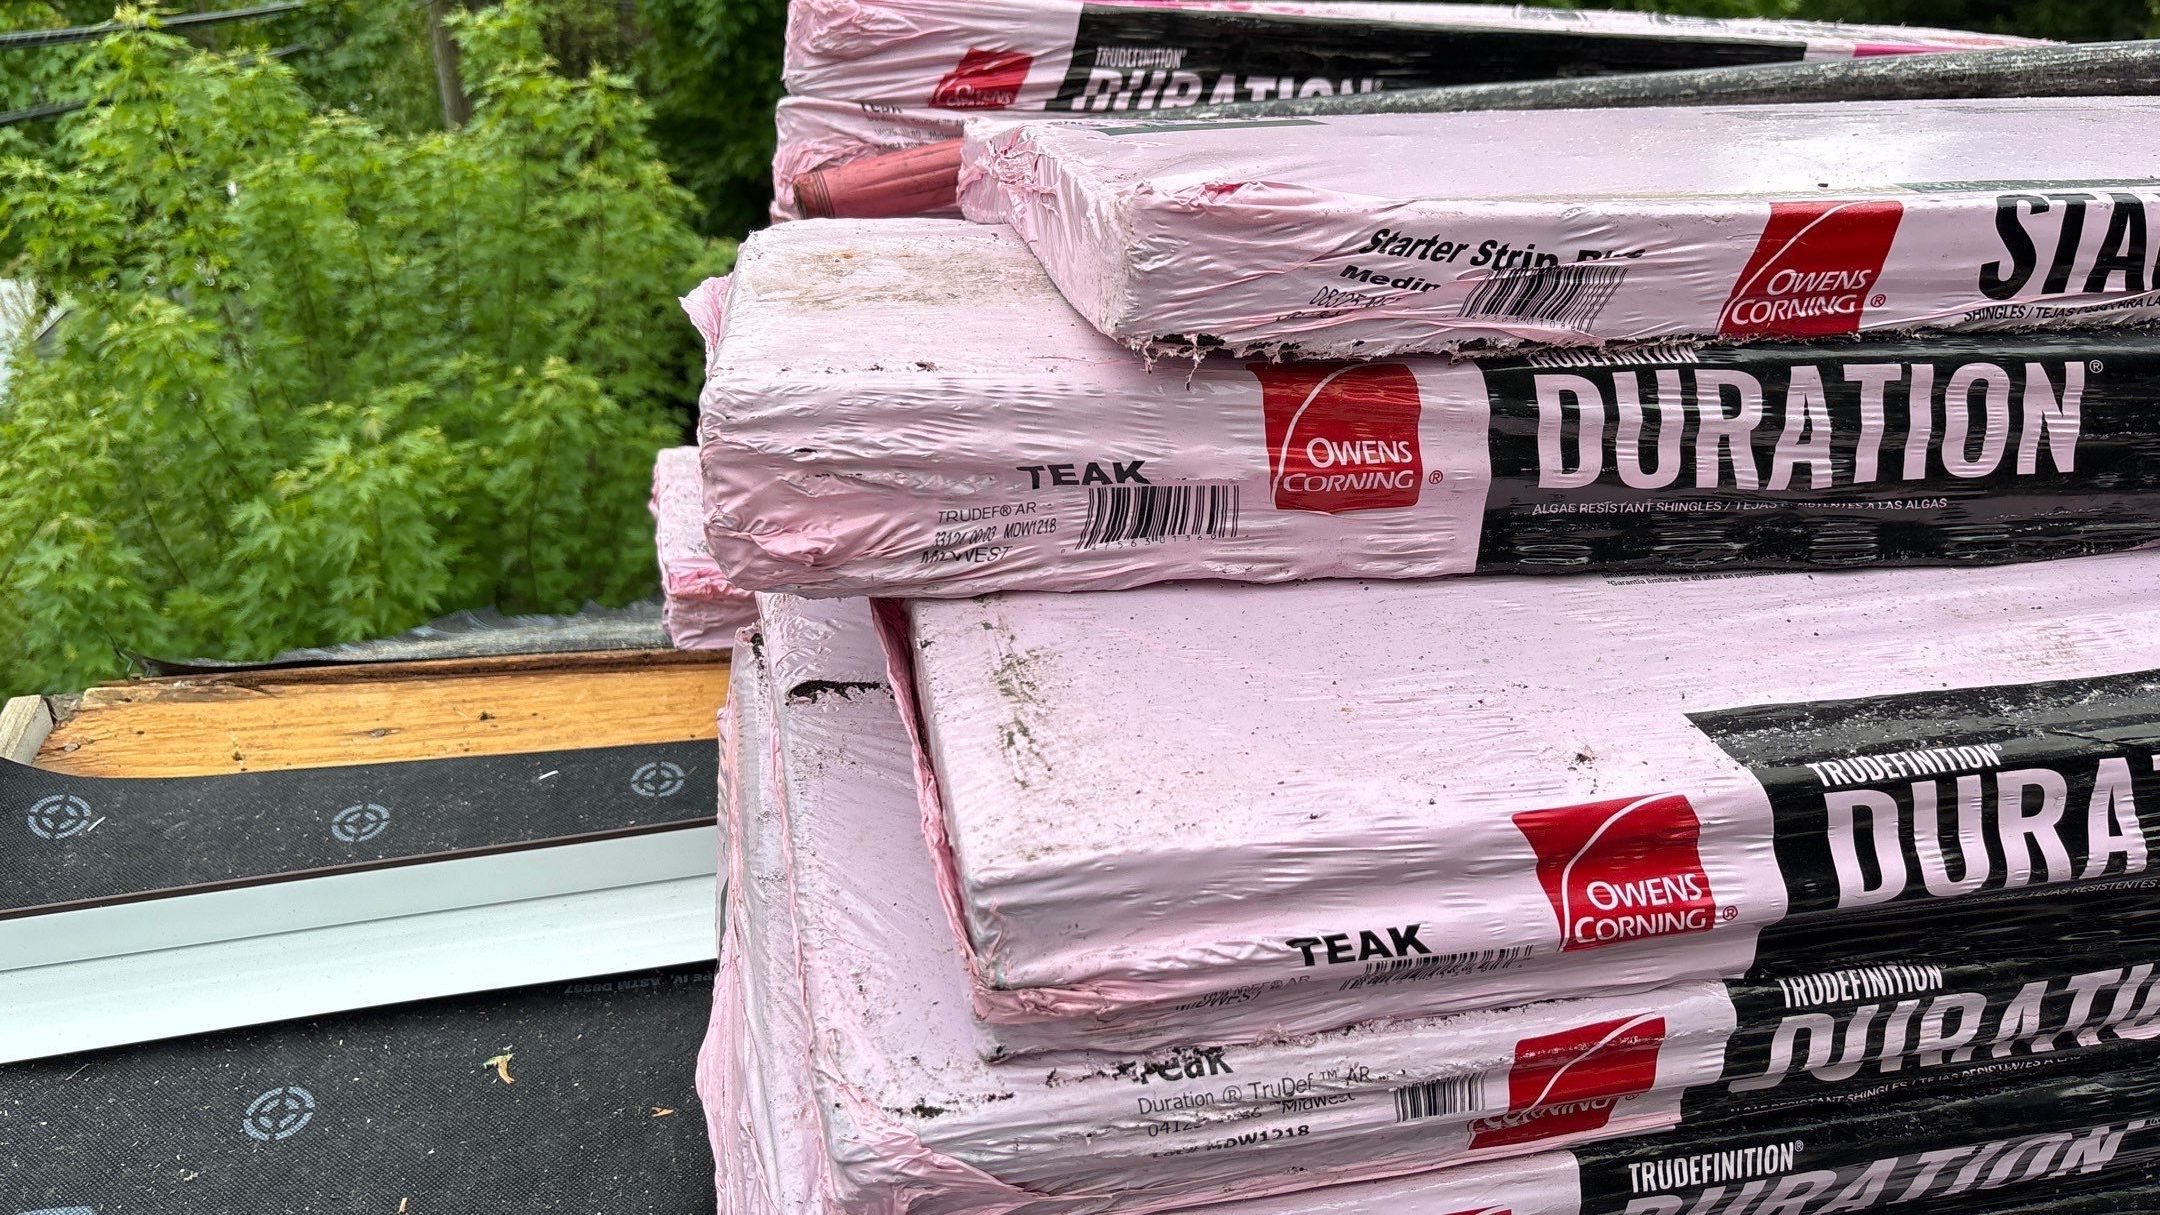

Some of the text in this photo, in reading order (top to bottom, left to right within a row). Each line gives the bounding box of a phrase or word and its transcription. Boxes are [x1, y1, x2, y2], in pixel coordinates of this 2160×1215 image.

[1365, 228, 1469, 265] Starter
[1767, 269, 1872, 296] OWENS
[1731, 295, 1858, 325] CORNING
[1964, 305, 2026, 322] SHINGLES
[1306, 437, 1413, 469] OWENS
[1016, 460, 1151, 490] TEAK
[1283, 470, 1414, 492] CORNING
[1015, 501, 1036, 516] AR
[1579, 501, 1652, 514] RESISTANT
[1656, 500, 1722, 512] SHINGLES
[1905, 498, 1948, 510] ALGAS
[1003, 518, 1057, 539] MDW1218
[1586, 873, 1702, 910] OWENS
[1574, 909, 1706, 943] CORNING
[1285, 923, 1433, 967] TEAK
[1138, 1091, 1215, 1115] Duration
[1248, 1073, 1313, 1100] TruDef
[1345, 1065, 1373, 1086] AR
